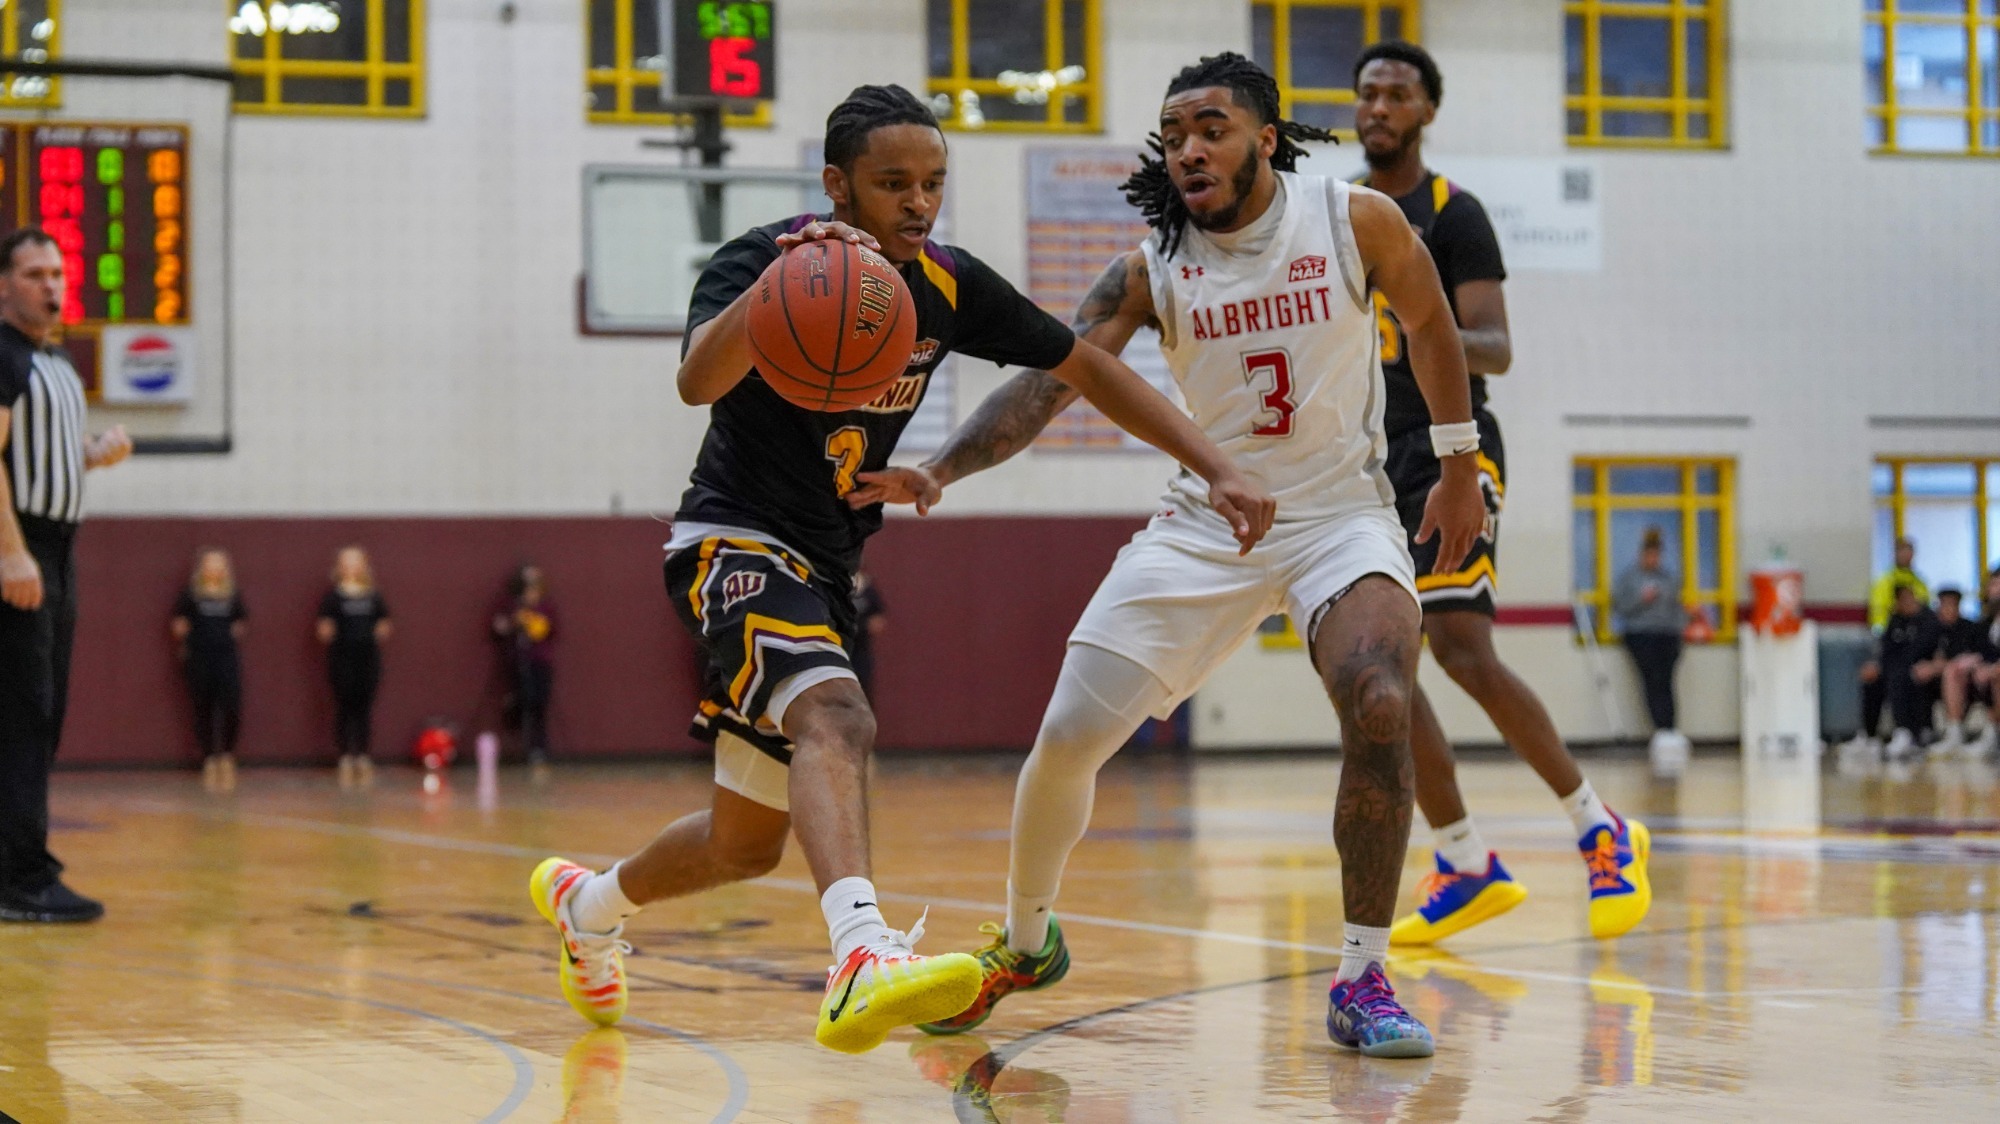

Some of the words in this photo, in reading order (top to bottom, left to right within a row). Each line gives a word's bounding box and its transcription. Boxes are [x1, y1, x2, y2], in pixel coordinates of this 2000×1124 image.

[1291, 264, 1324, 281] MAC
[855, 270, 895, 340] ROCK
[1192, 286, 1332, 341] ALBRIGHT
[1240, 347, 1299, 438] 3
[723, 571, 766, 610] AU
